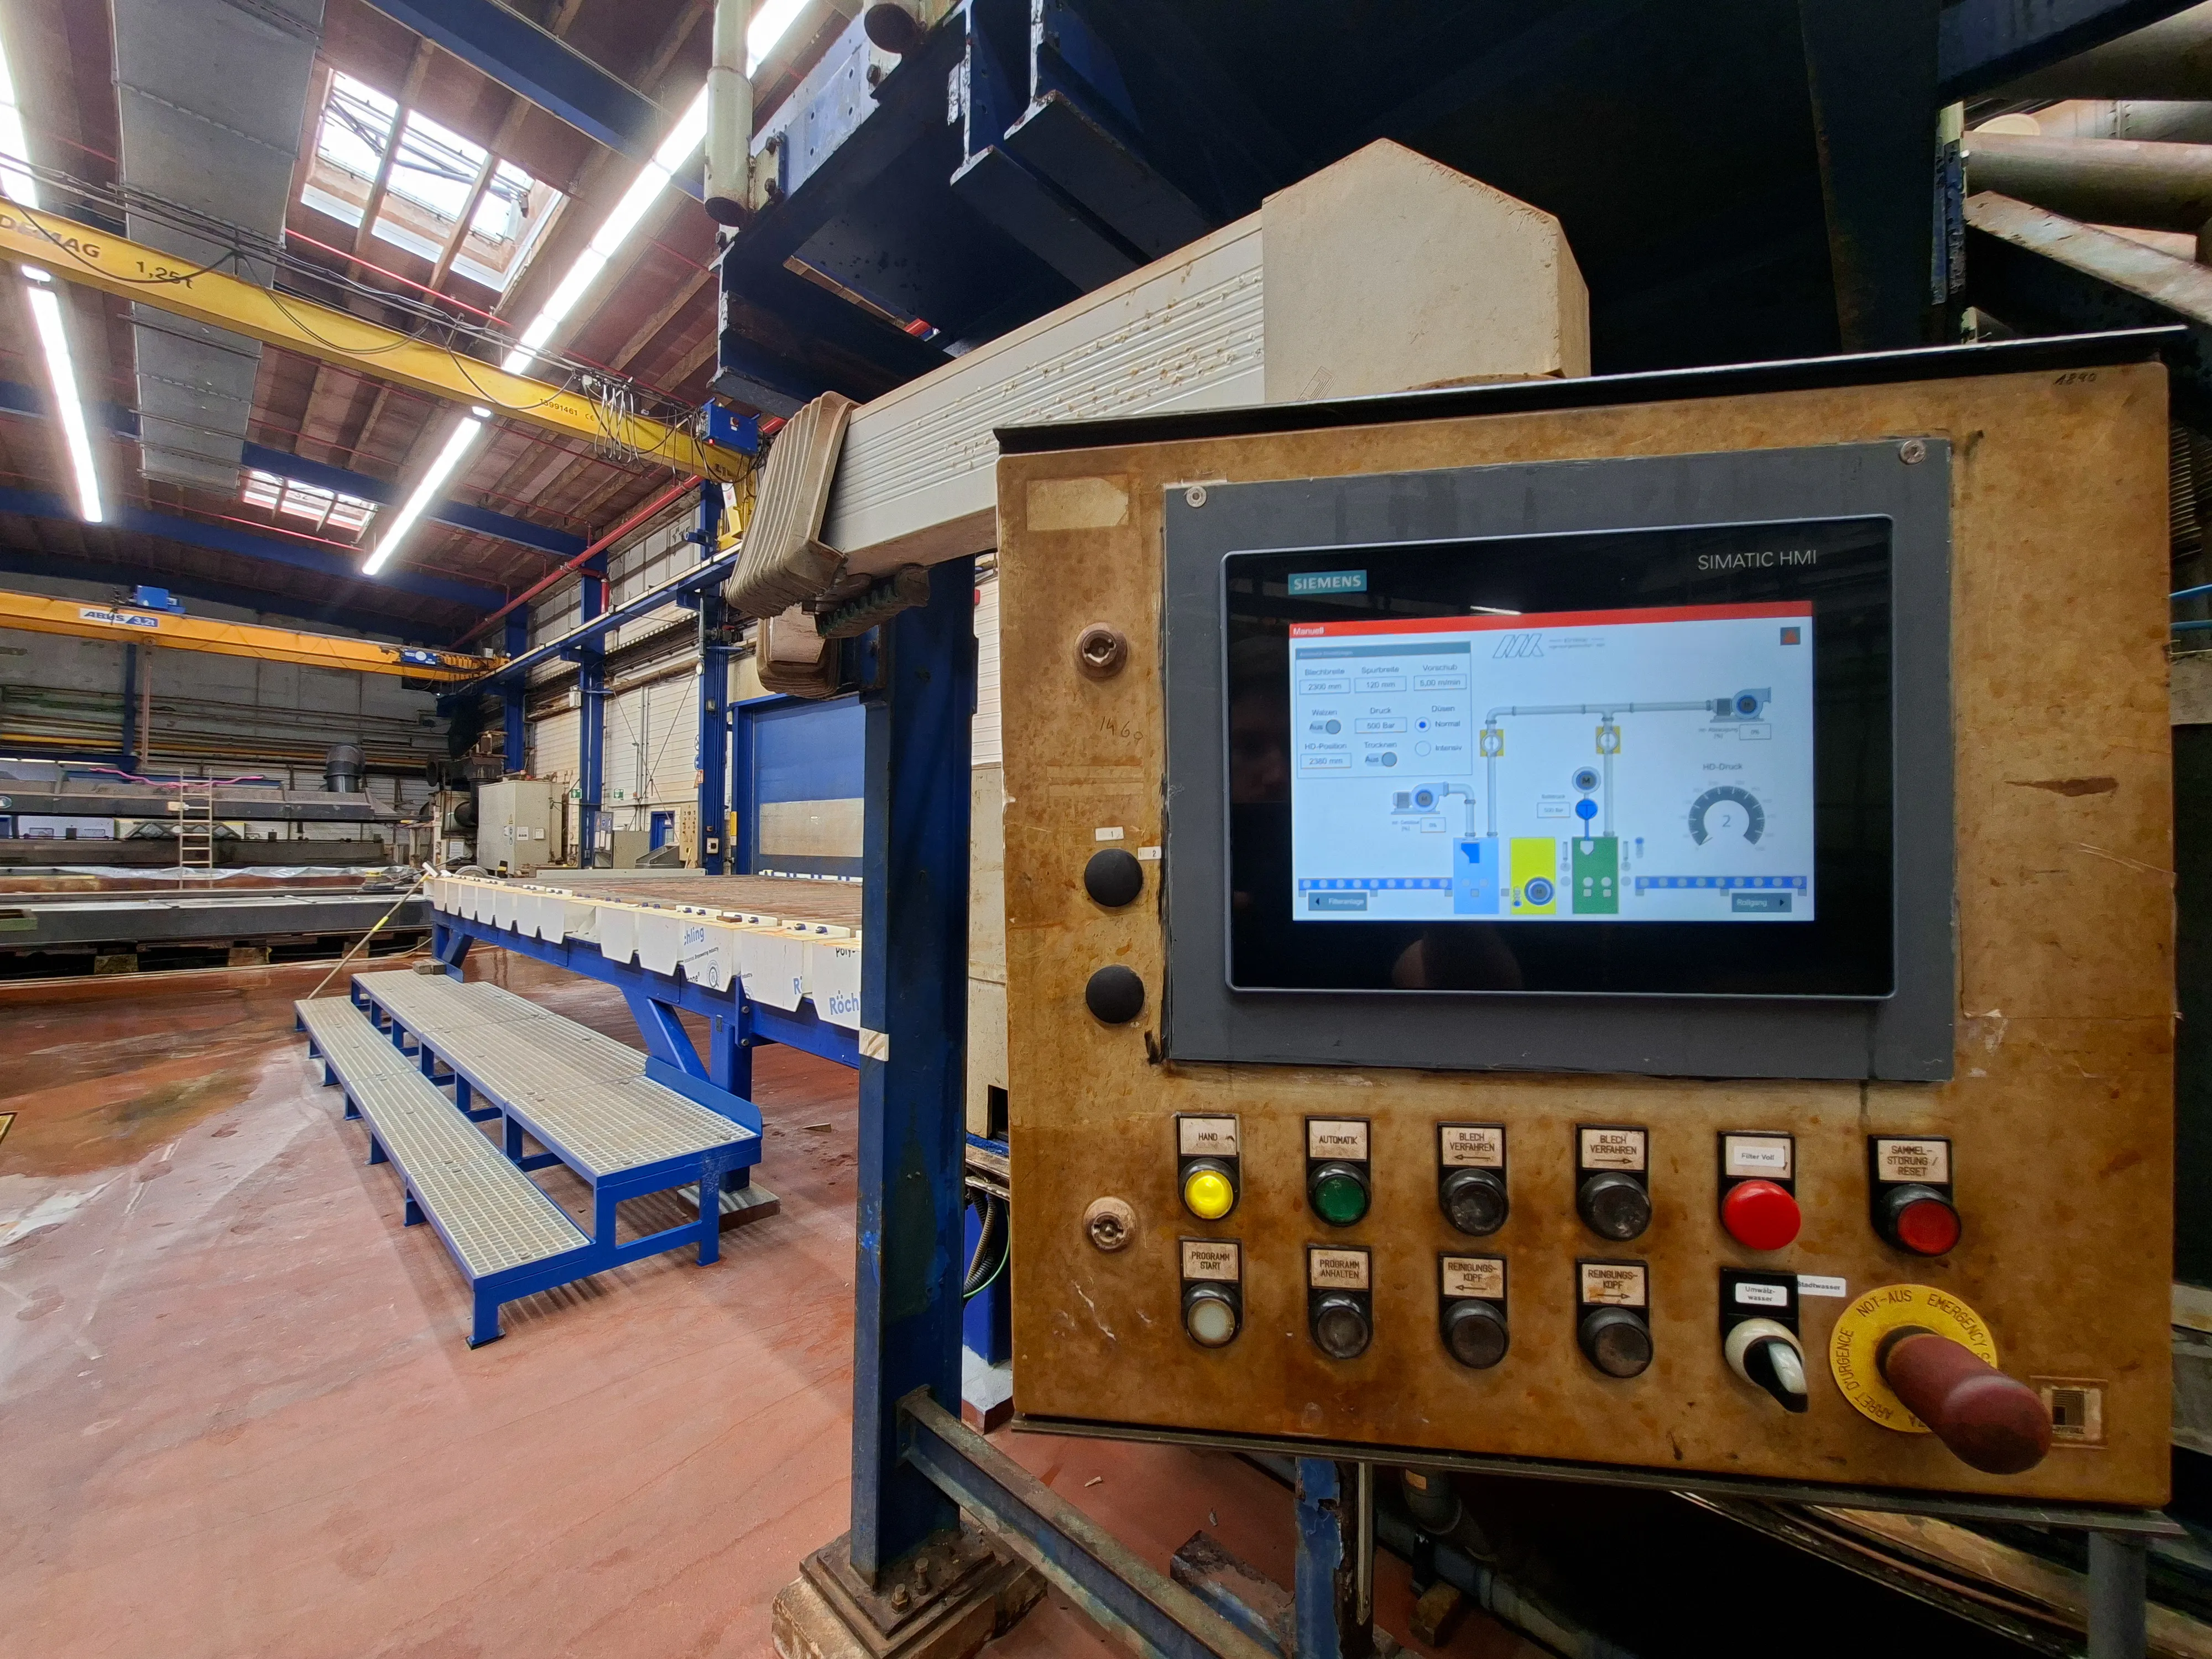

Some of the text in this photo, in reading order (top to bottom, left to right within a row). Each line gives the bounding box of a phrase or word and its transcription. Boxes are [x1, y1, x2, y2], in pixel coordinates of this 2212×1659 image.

[0, 214, 101, 258] DEMAG
[1698, 549, 1817, 570] SIMATIC HMI
[1293, 575, 1361, 591] SIEMENS
[84, 611, 126, 622] ABUS
[1293, 626, 1324, 636] Manuell
[1702, 763, 1744, 771] HD-Druck
[1722, 815, 1731, 828] 2
[830, 990, 861, 1015] Röch
[1198, 1132, 1218, 1141] HAND
[1318, 1135, 1358, 1145] AUTOMATIK
[1459, 1132, 1485, 1142] BLECH
[1599, 1134, 1627, 1144] BLECH
[1449, 1142, 1495, 1152] VERFAHREN
[1590, 1144, 1637, 1155] VERFAHREN
[1897, 1166, 1927, 1177] RESET
[1191, 1251, 1230, 1261] PROGRAMM
[1199, 1261, 1222, 1271] START
[1319, 1259, 1360, 1269] PROGRAMM
[1448, 1262, 1498, 1273] REINIGUNGS-
[1320, 1269, 1360, 1279] ANHALTEN
[1463, 1272, 1484, 1282] KOPF
[1603, 1280, 1624, 1290] KOPF
[1745, 1286, 1776, 1294] Umwälz-
[1797, 1281, 1841, 1291] Stadtwasser
[1855, 1289, 1912, 1317] NOT-AUS
[1927, 1293, 1988, 1348] EMERGENCY
[1835, 1327, 1860, 1391] D'URGENCE
